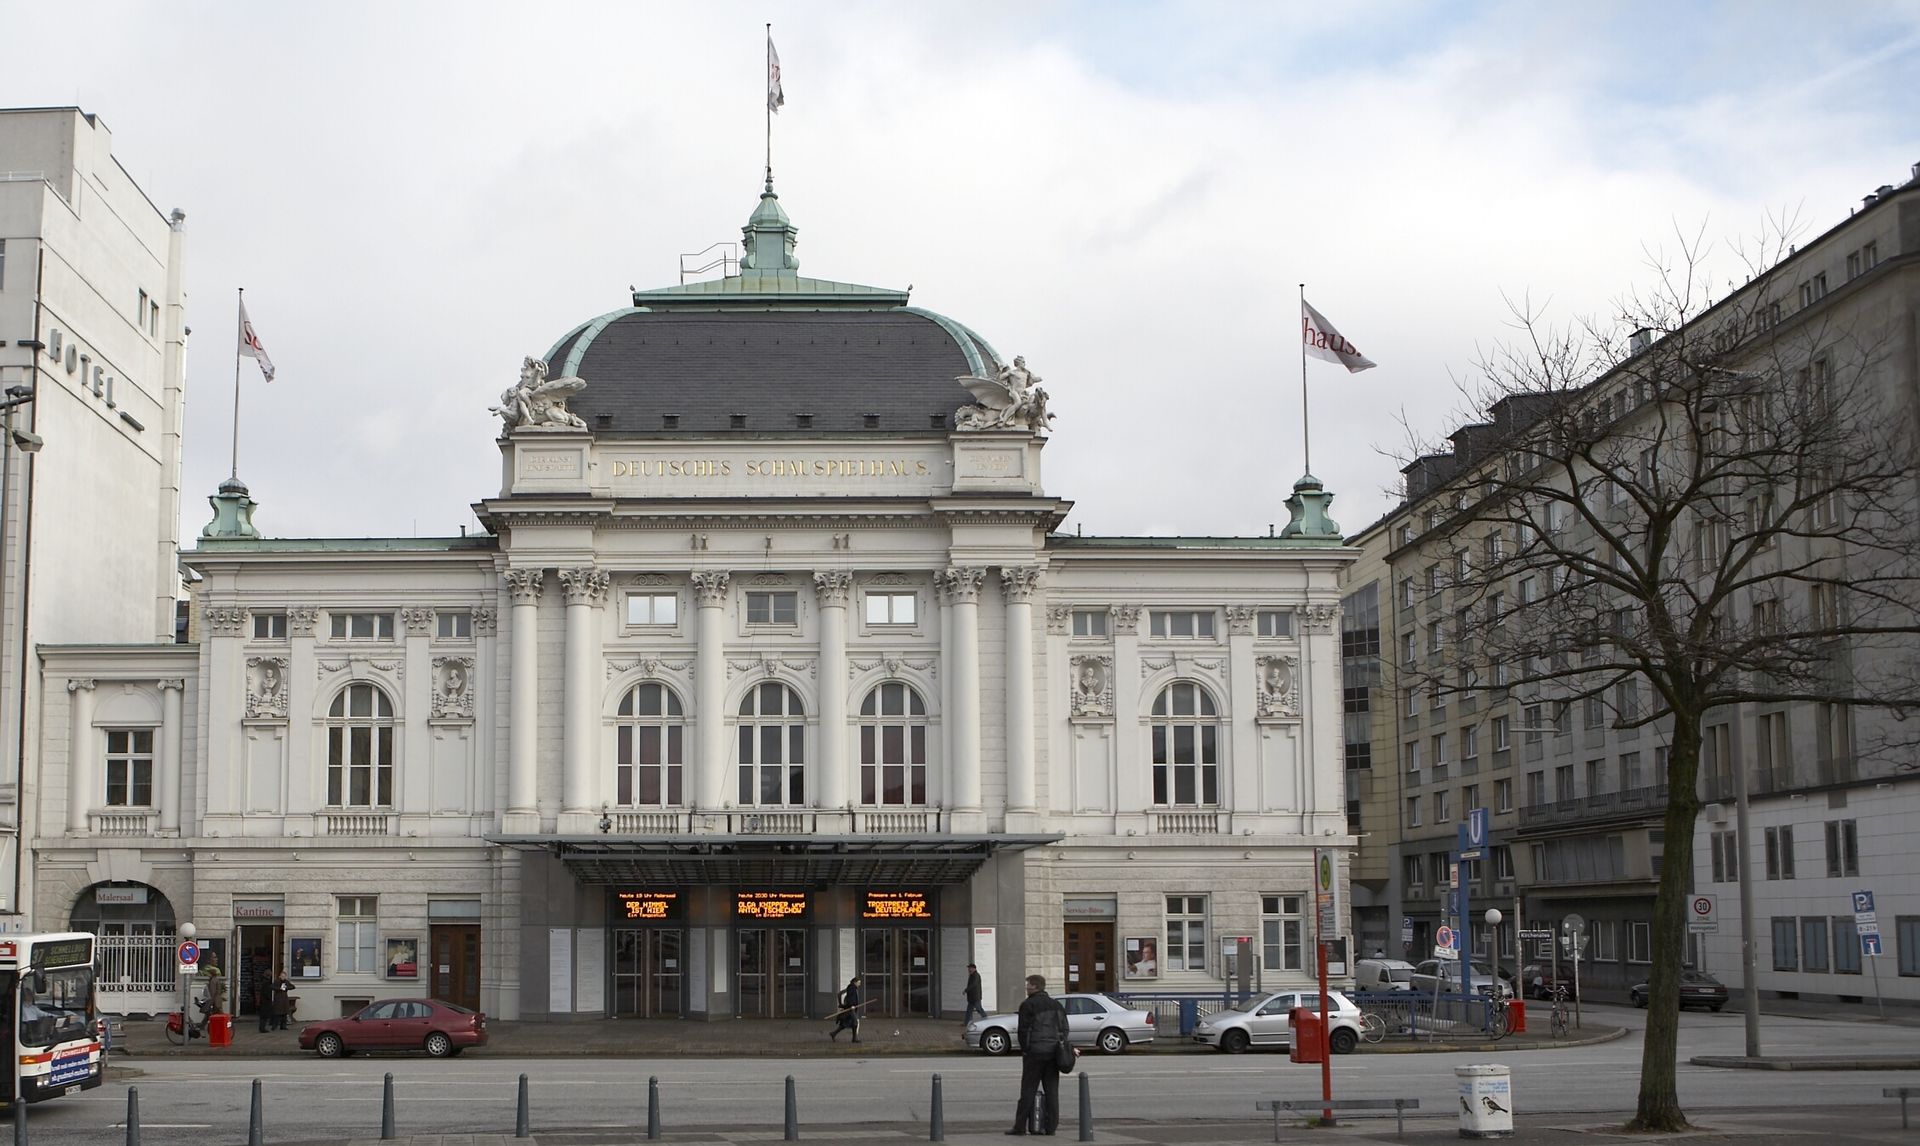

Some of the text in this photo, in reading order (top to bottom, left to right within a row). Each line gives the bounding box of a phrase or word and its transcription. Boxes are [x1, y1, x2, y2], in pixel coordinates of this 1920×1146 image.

[50, 328, 116, 409] HOTEL
[613, 460, 731, 477] DEUTSCHES
[1470, 813, 1481, 844] U
[97, 893, 134, 902] Malersaal
[1855, 894, 1867, 910] P
[236, 907, 274, 916] Kantine
[1697, 902, 1708, 911] 30
